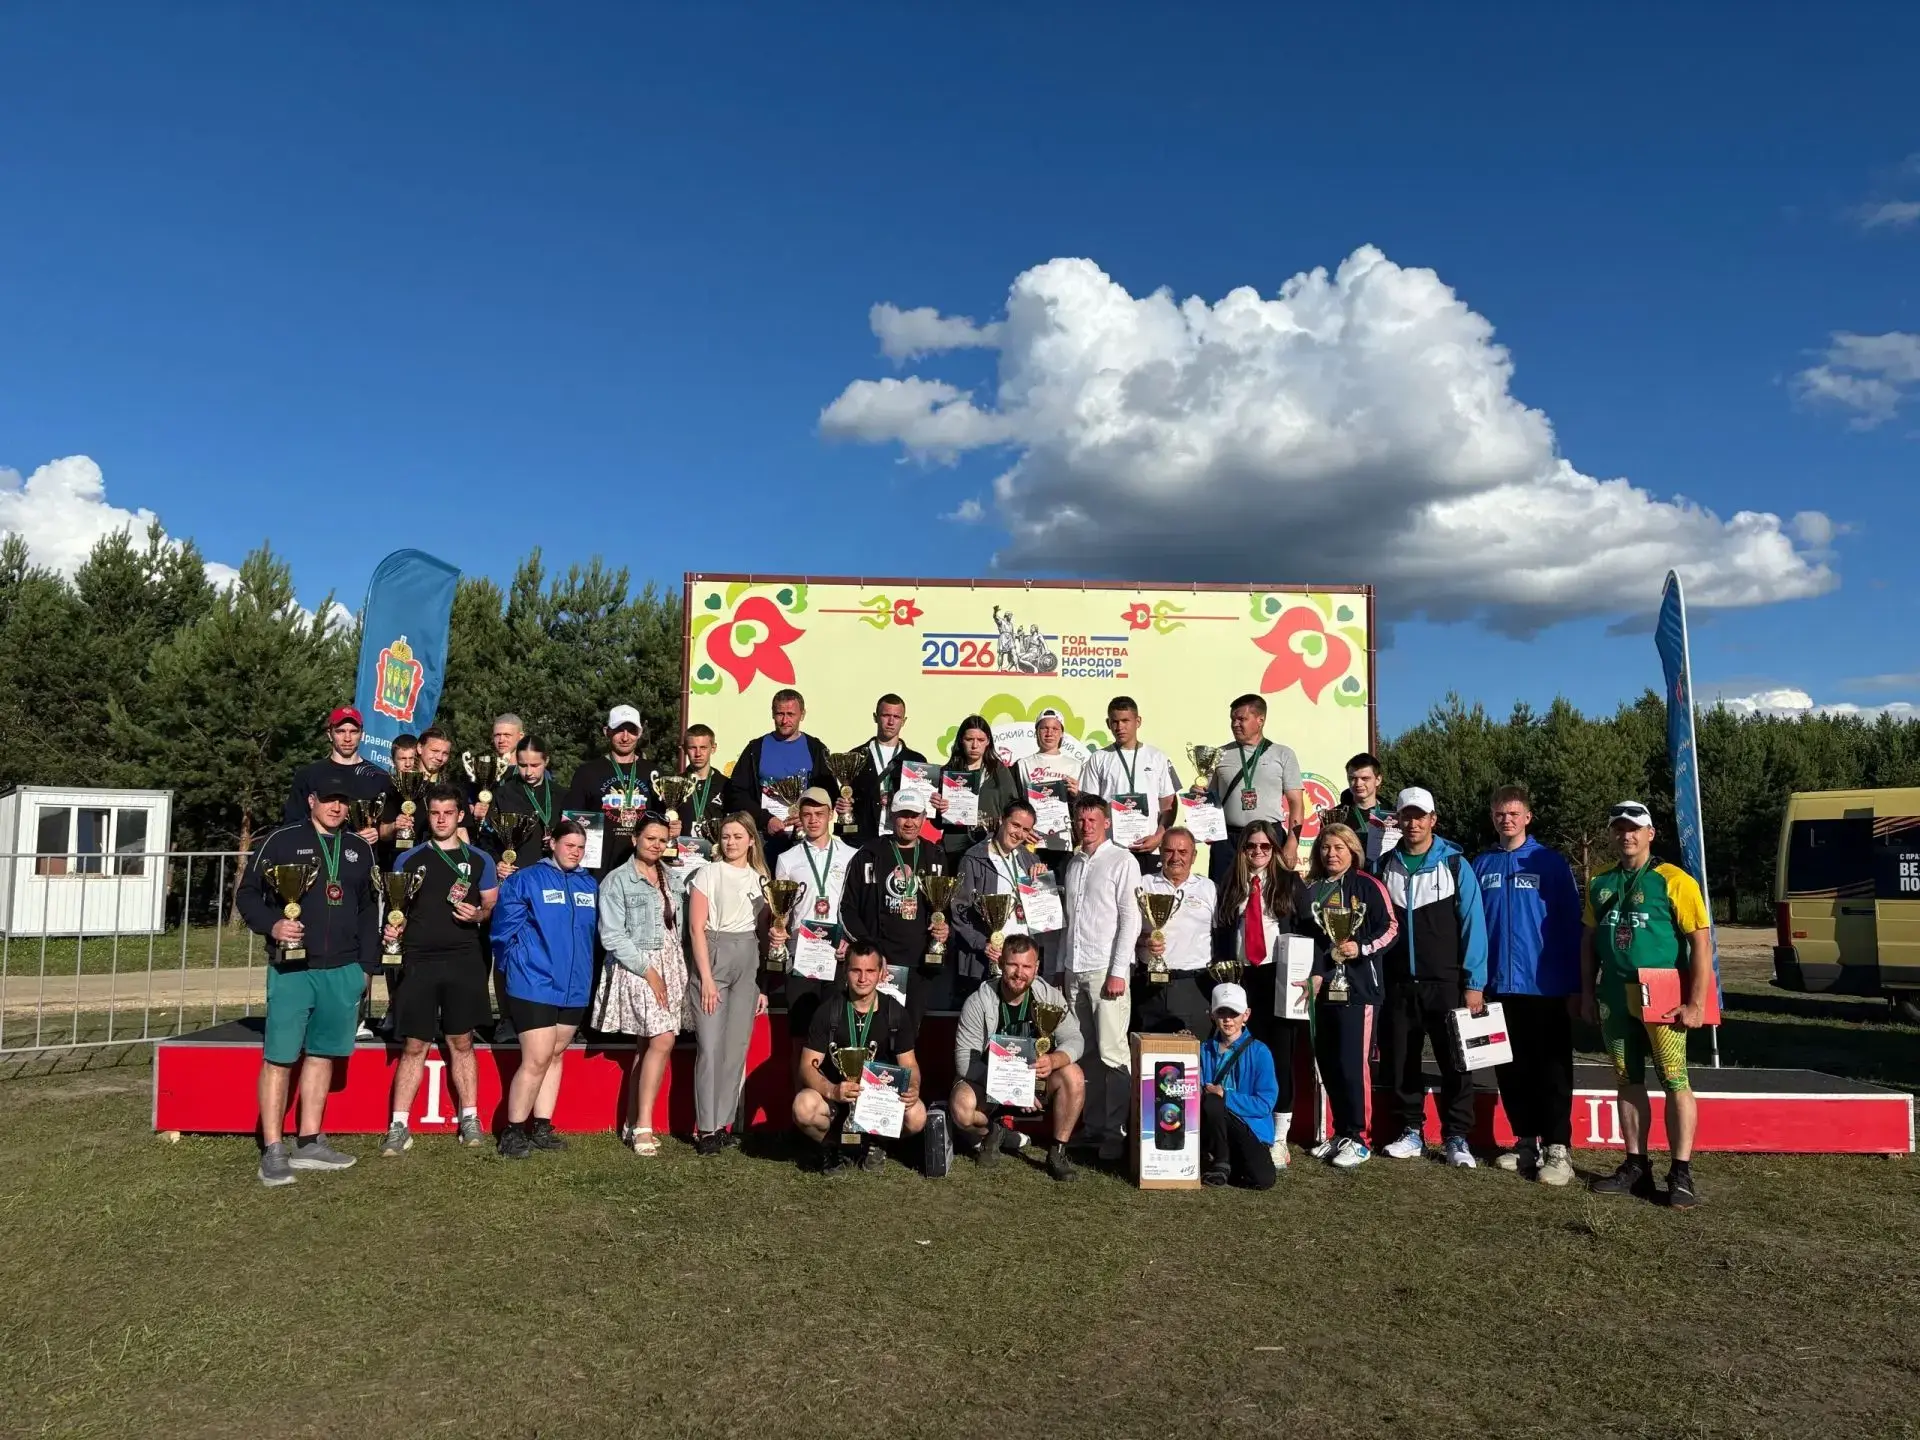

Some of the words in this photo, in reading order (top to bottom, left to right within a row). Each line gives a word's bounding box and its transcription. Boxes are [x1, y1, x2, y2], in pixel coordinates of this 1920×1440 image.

[1062, 635, 1087, 646] ГОД
[922, 640, 995, 668] 2026
[1062, 647, 1128, 657] ЕДИНСТВА
[1062, 658, 1122, 669] НАРОДОВ
[1062, 669, 1114, 678] РОССИИ
[1900, 862, 1920, 876] ВЕ
